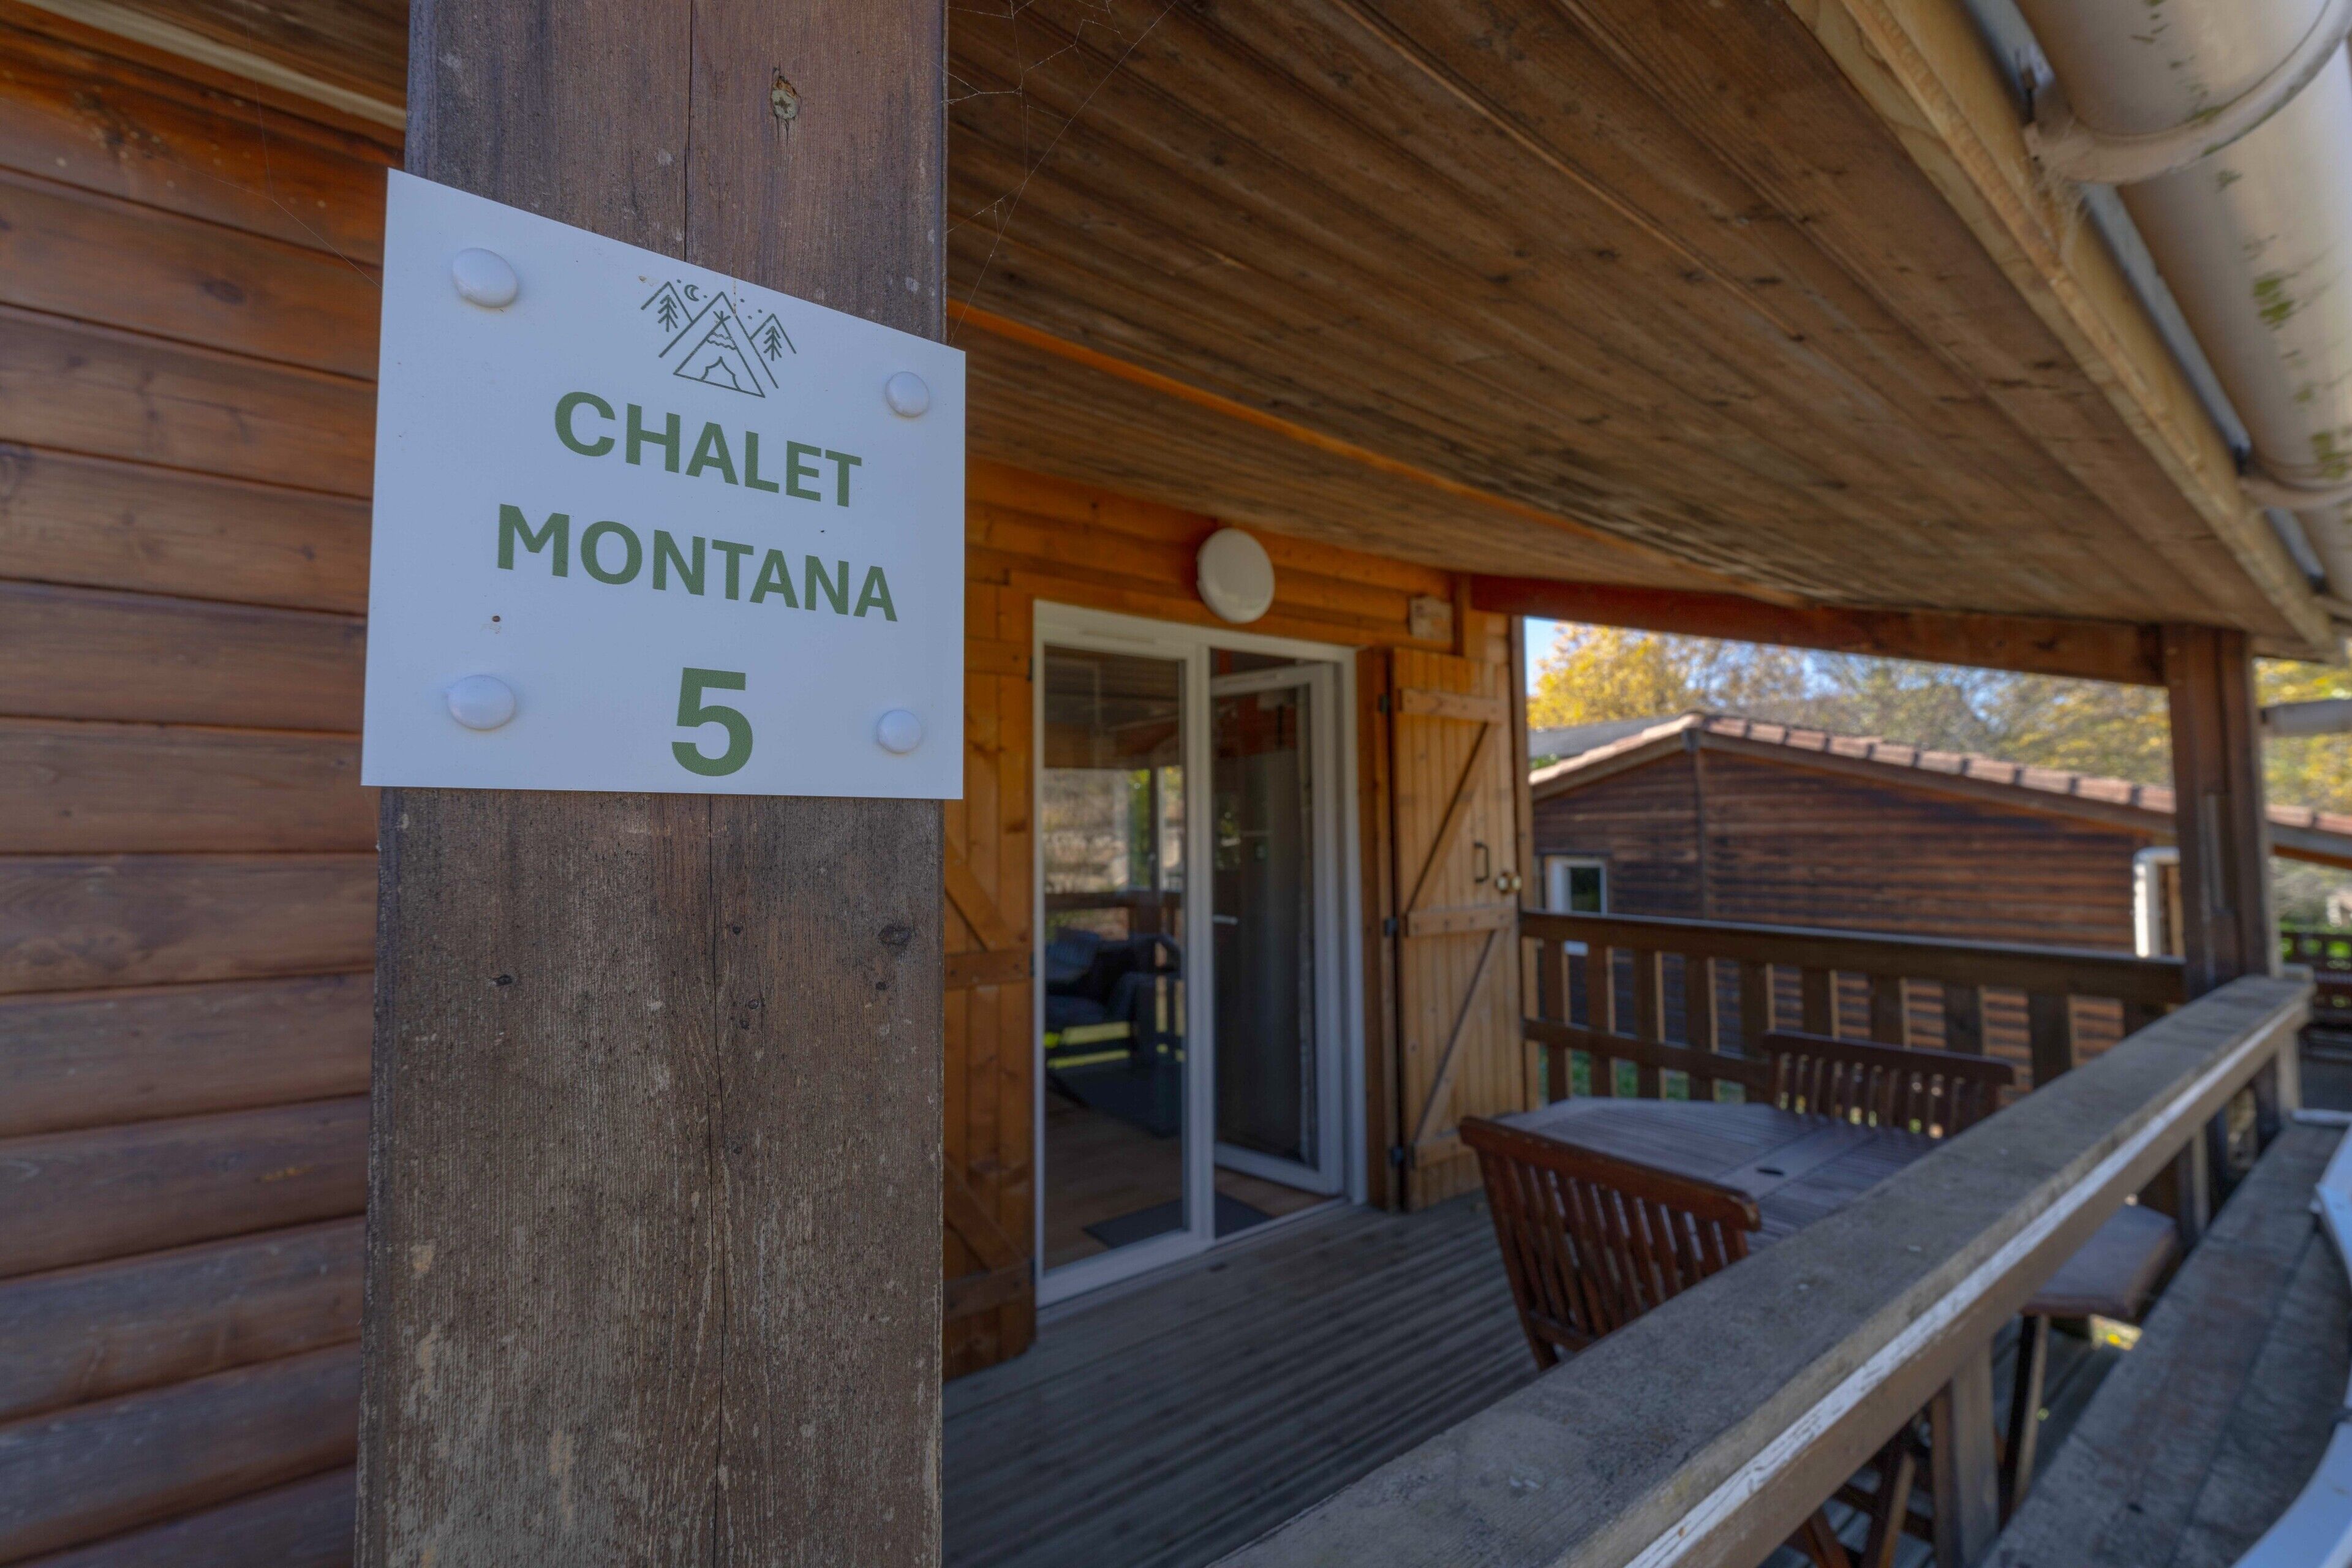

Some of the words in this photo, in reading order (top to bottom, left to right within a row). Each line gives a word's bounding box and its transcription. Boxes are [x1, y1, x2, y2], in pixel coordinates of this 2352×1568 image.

[554, 391, 862, 508] CHALET
[497, 503, 899, 622] MONTANA
[671, 667, 753, 777] 5
